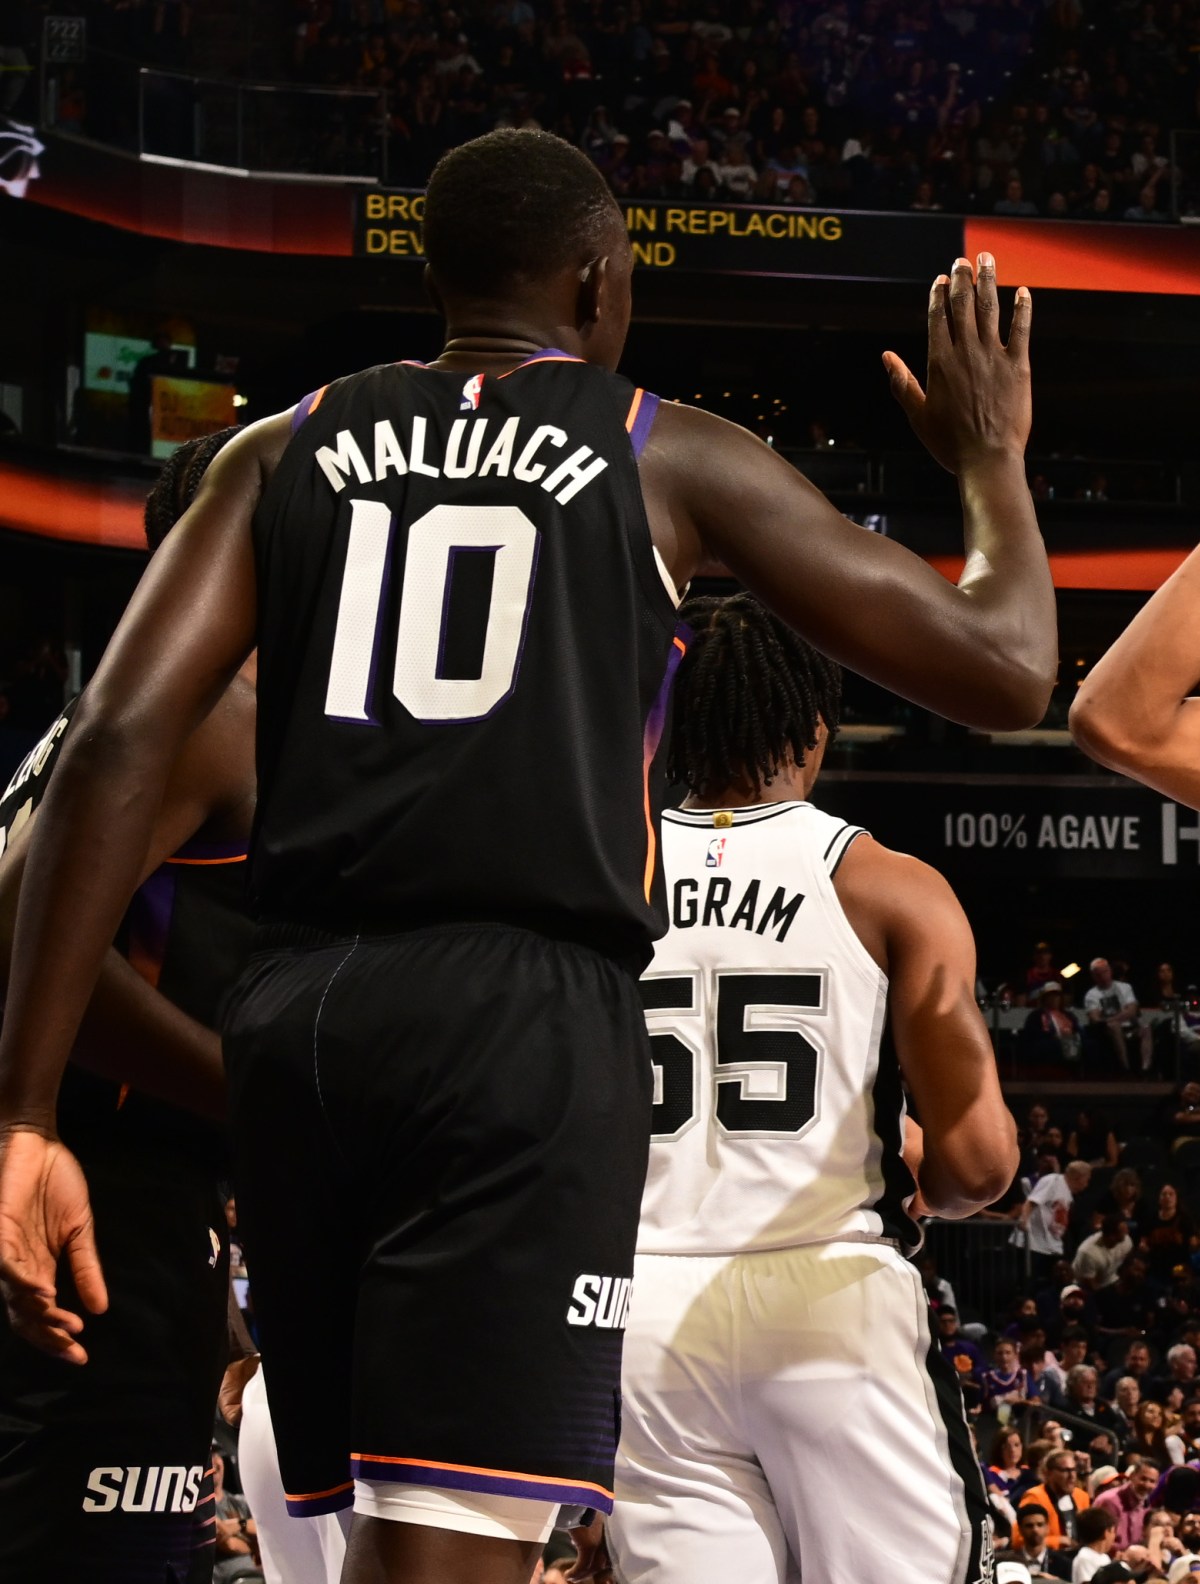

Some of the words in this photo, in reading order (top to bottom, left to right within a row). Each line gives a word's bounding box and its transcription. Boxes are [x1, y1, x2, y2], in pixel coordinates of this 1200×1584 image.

[666, 208, 843, 241] REPLACING
[315, 415, 609, 506] MALUACH
[324, 499, 543, 727] 10
[944, 812, 1028, 850] 100%
[1037, 814, 1141, 851] AGAVE
[566, 1273, 633, 1329] SUN
[82, 1465, 204, 1514] SUNS
